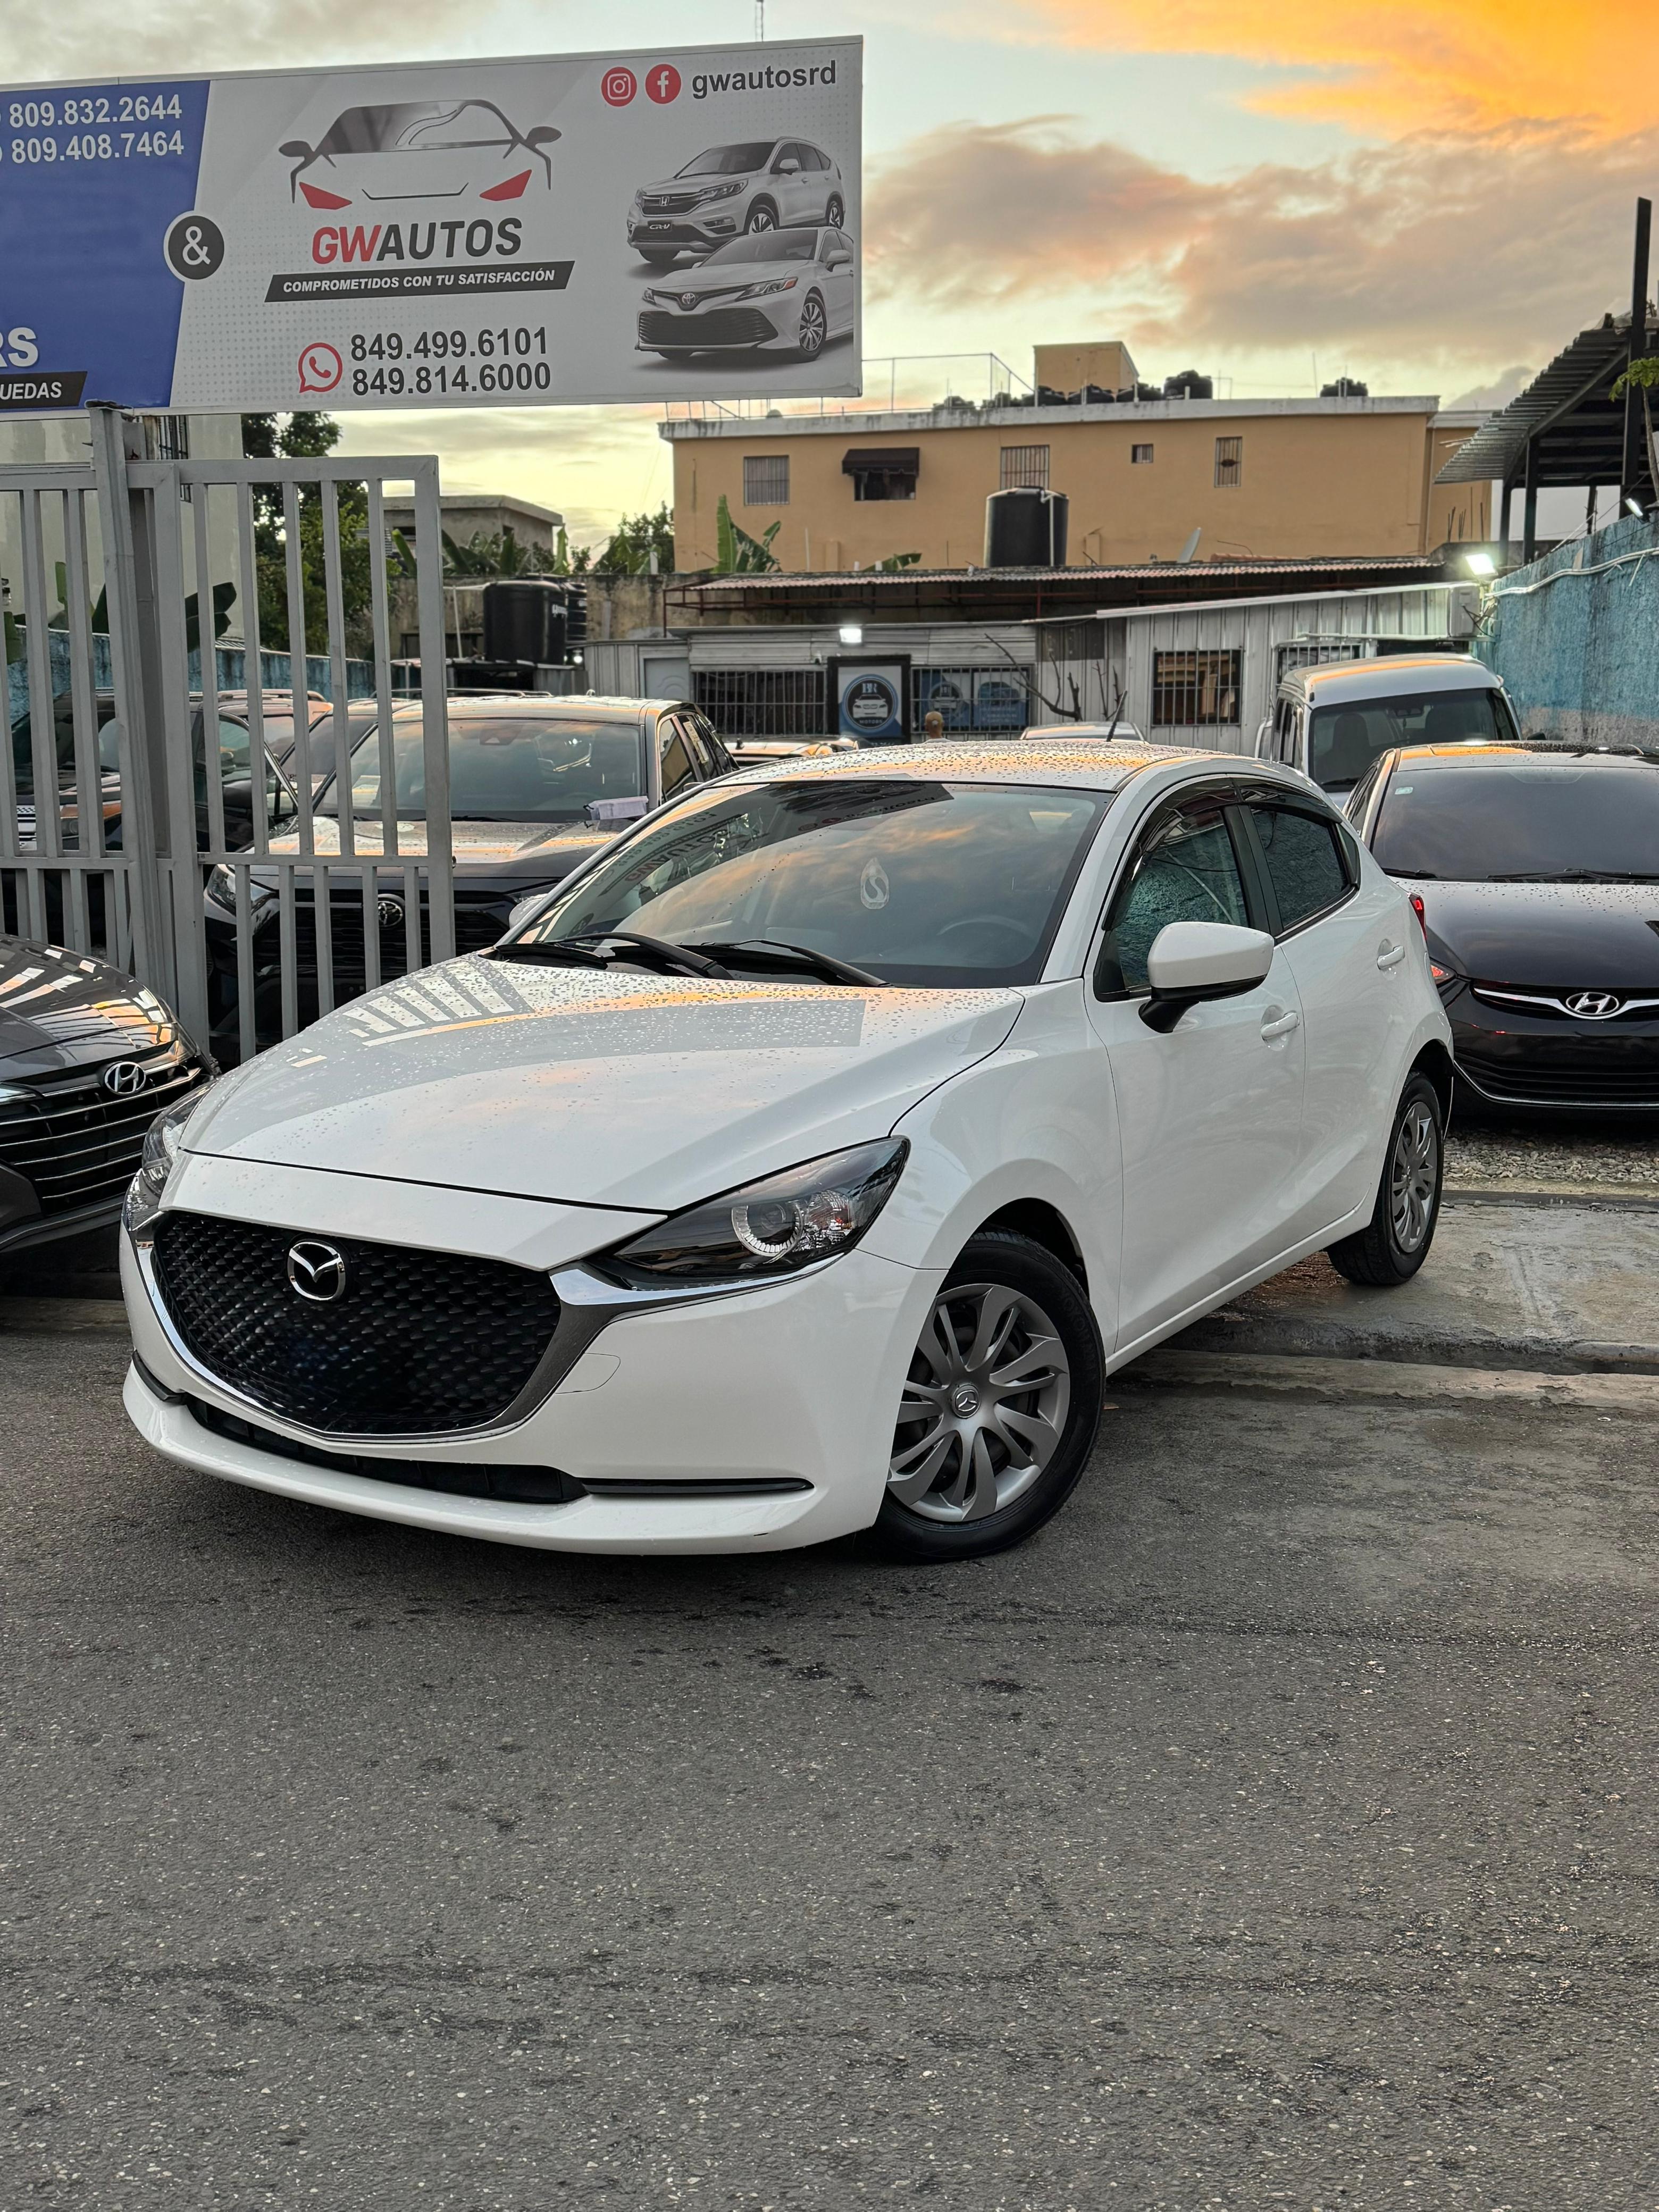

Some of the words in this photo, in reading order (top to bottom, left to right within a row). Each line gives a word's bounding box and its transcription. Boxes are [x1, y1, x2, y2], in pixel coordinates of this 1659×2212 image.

[692, 60, 836, 99] gwautosrd
[9, 94, 182, 128] 809.832.2644
[12, 130, 183, 163] 809.408.7464
[182, 226, 211, 265] &
[312, 217, 522, 264] GWAUTOS
[283, 276, 399, 293] COMPROMETIDOS
[403, 275, 432, 287] CON
[436, 274, 454, 286] TU
[458, 268, 555, 285] SATISFACCIÓN
[351, 326, 547, 362] 849.499.6101
[353, 362, 551, 396] 849.814.6000
